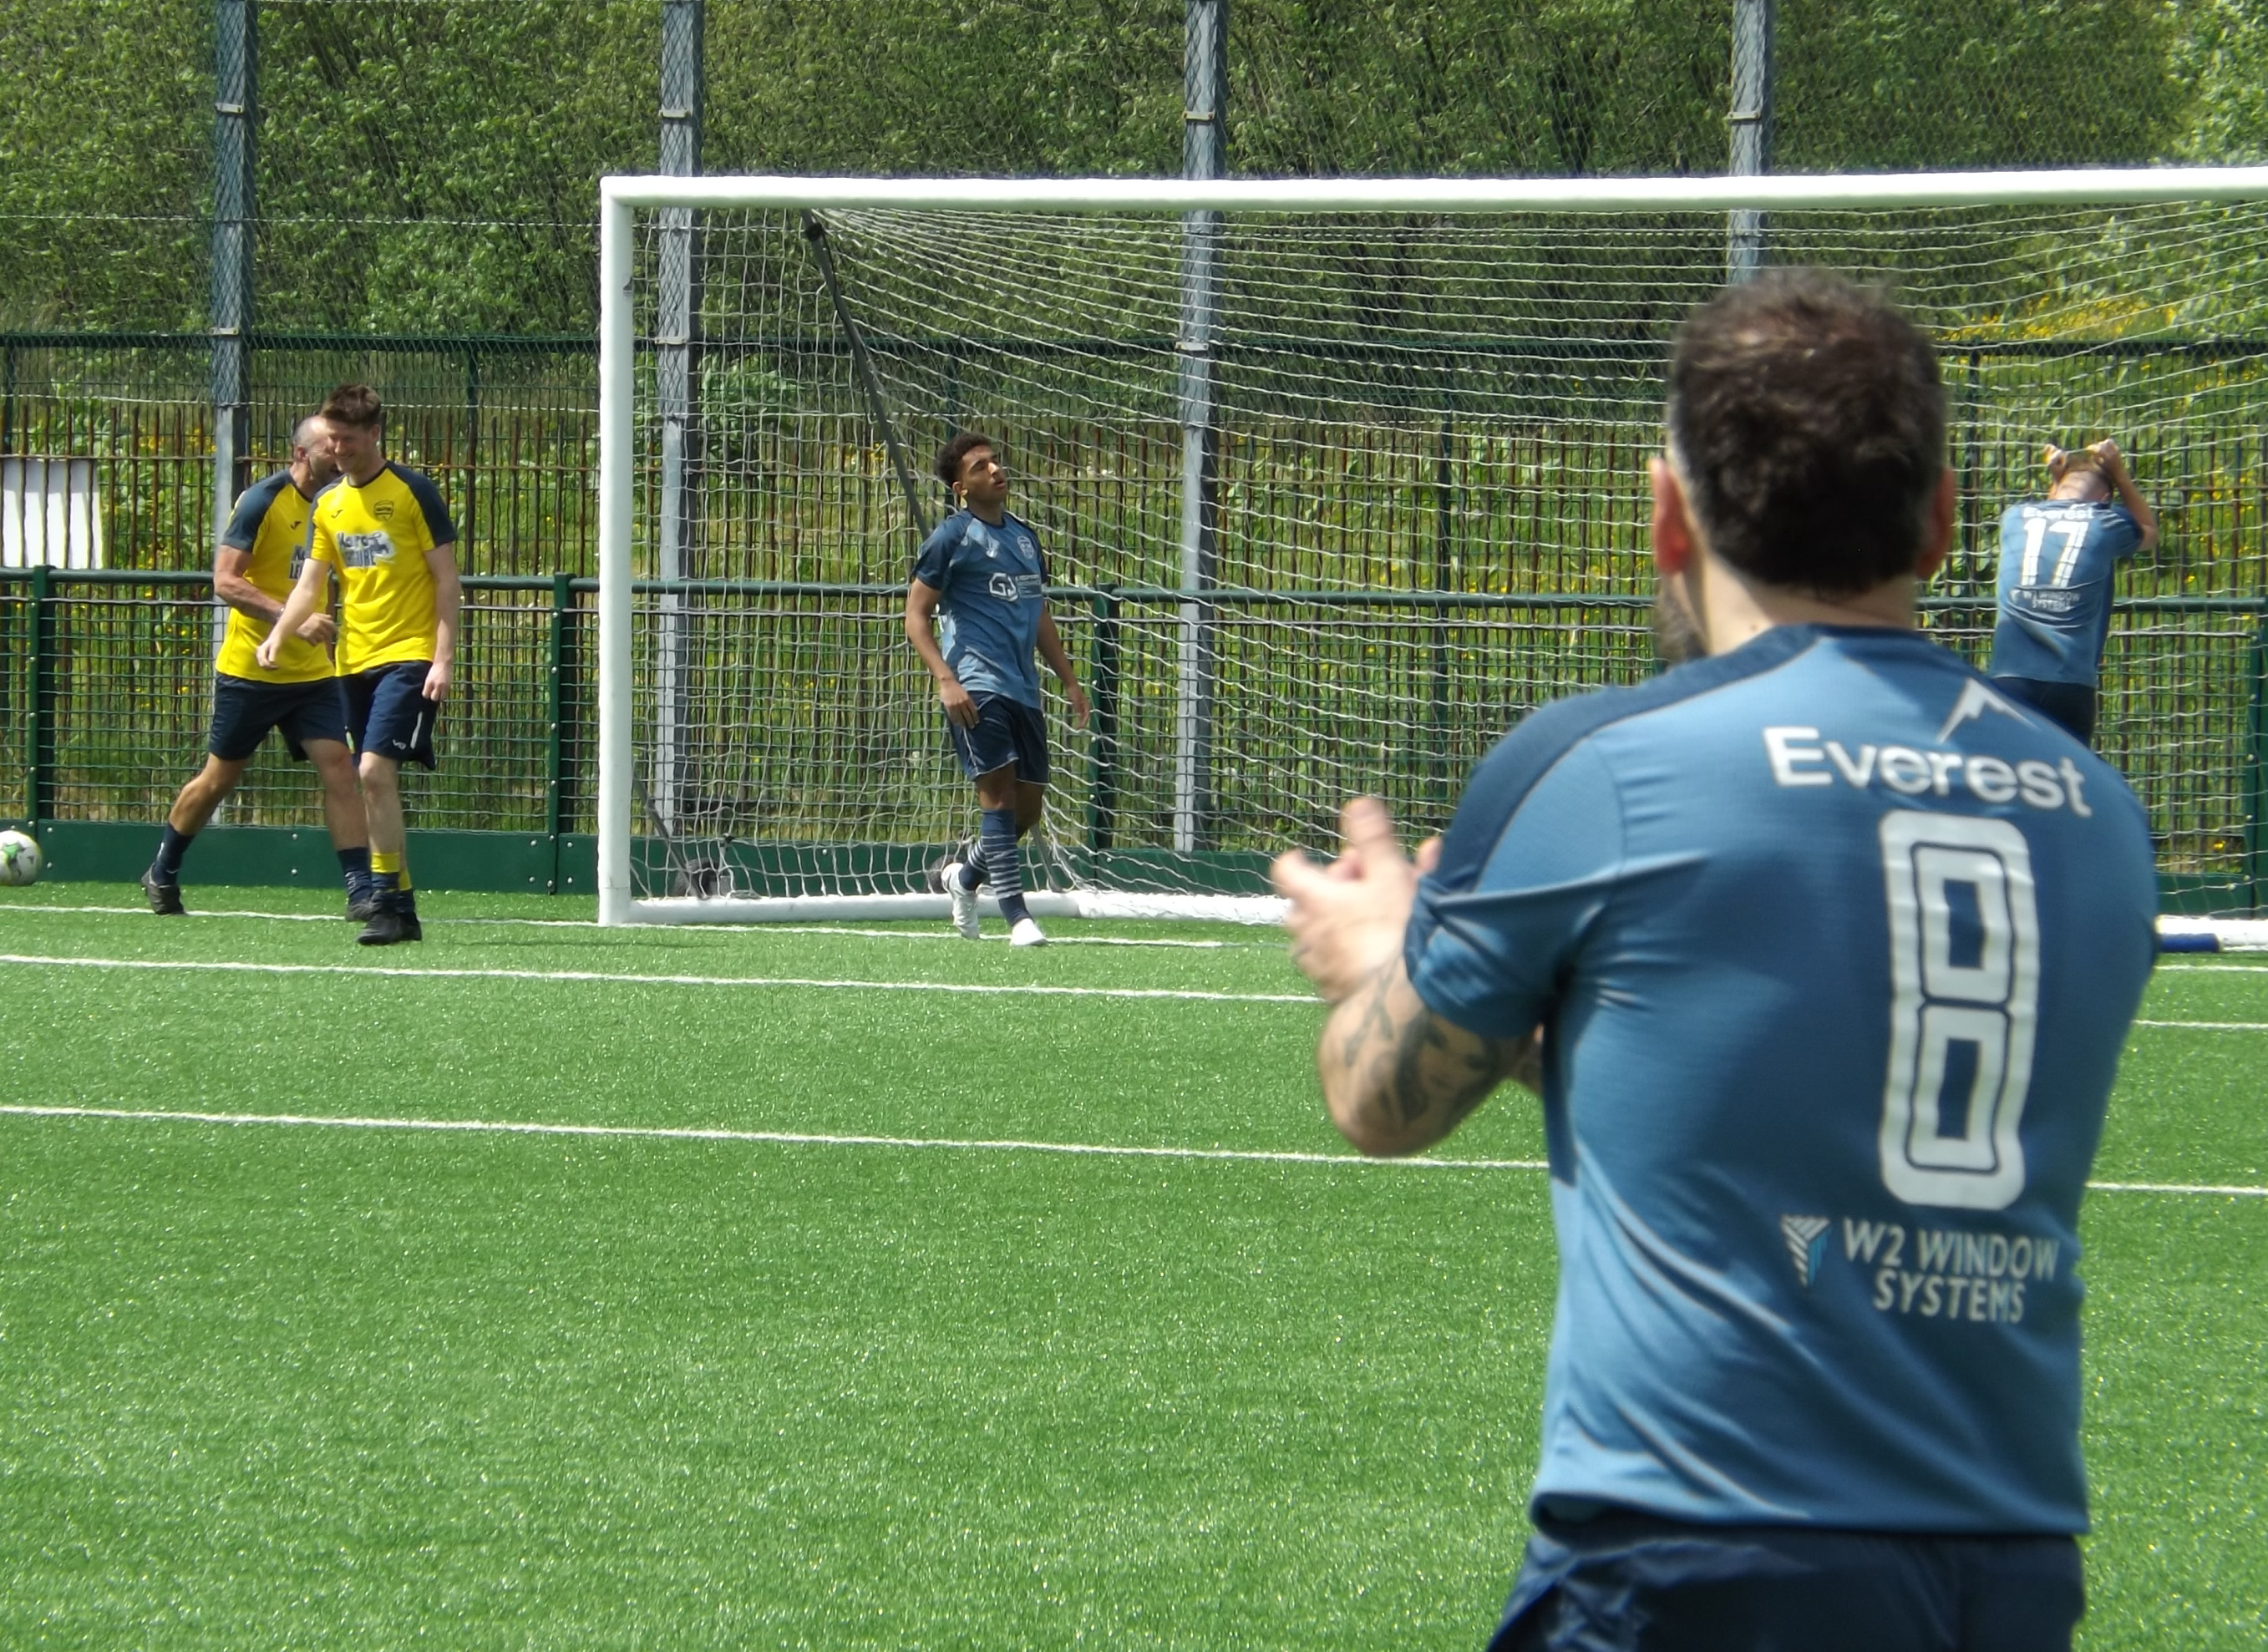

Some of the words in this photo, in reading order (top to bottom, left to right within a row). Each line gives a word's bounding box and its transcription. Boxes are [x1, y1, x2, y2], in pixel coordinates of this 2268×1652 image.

[2022, 518, 2088, 588] 17
[1763, 726, 2092, 818] Everest
[1879, 808, 2040, 1211] 8
[1842, 1217, 1905, 1267] W2
[1917, 1228, 2060, 1281] WINDOW
[1873, 1268, 2027, 1324] SYSTEMS
